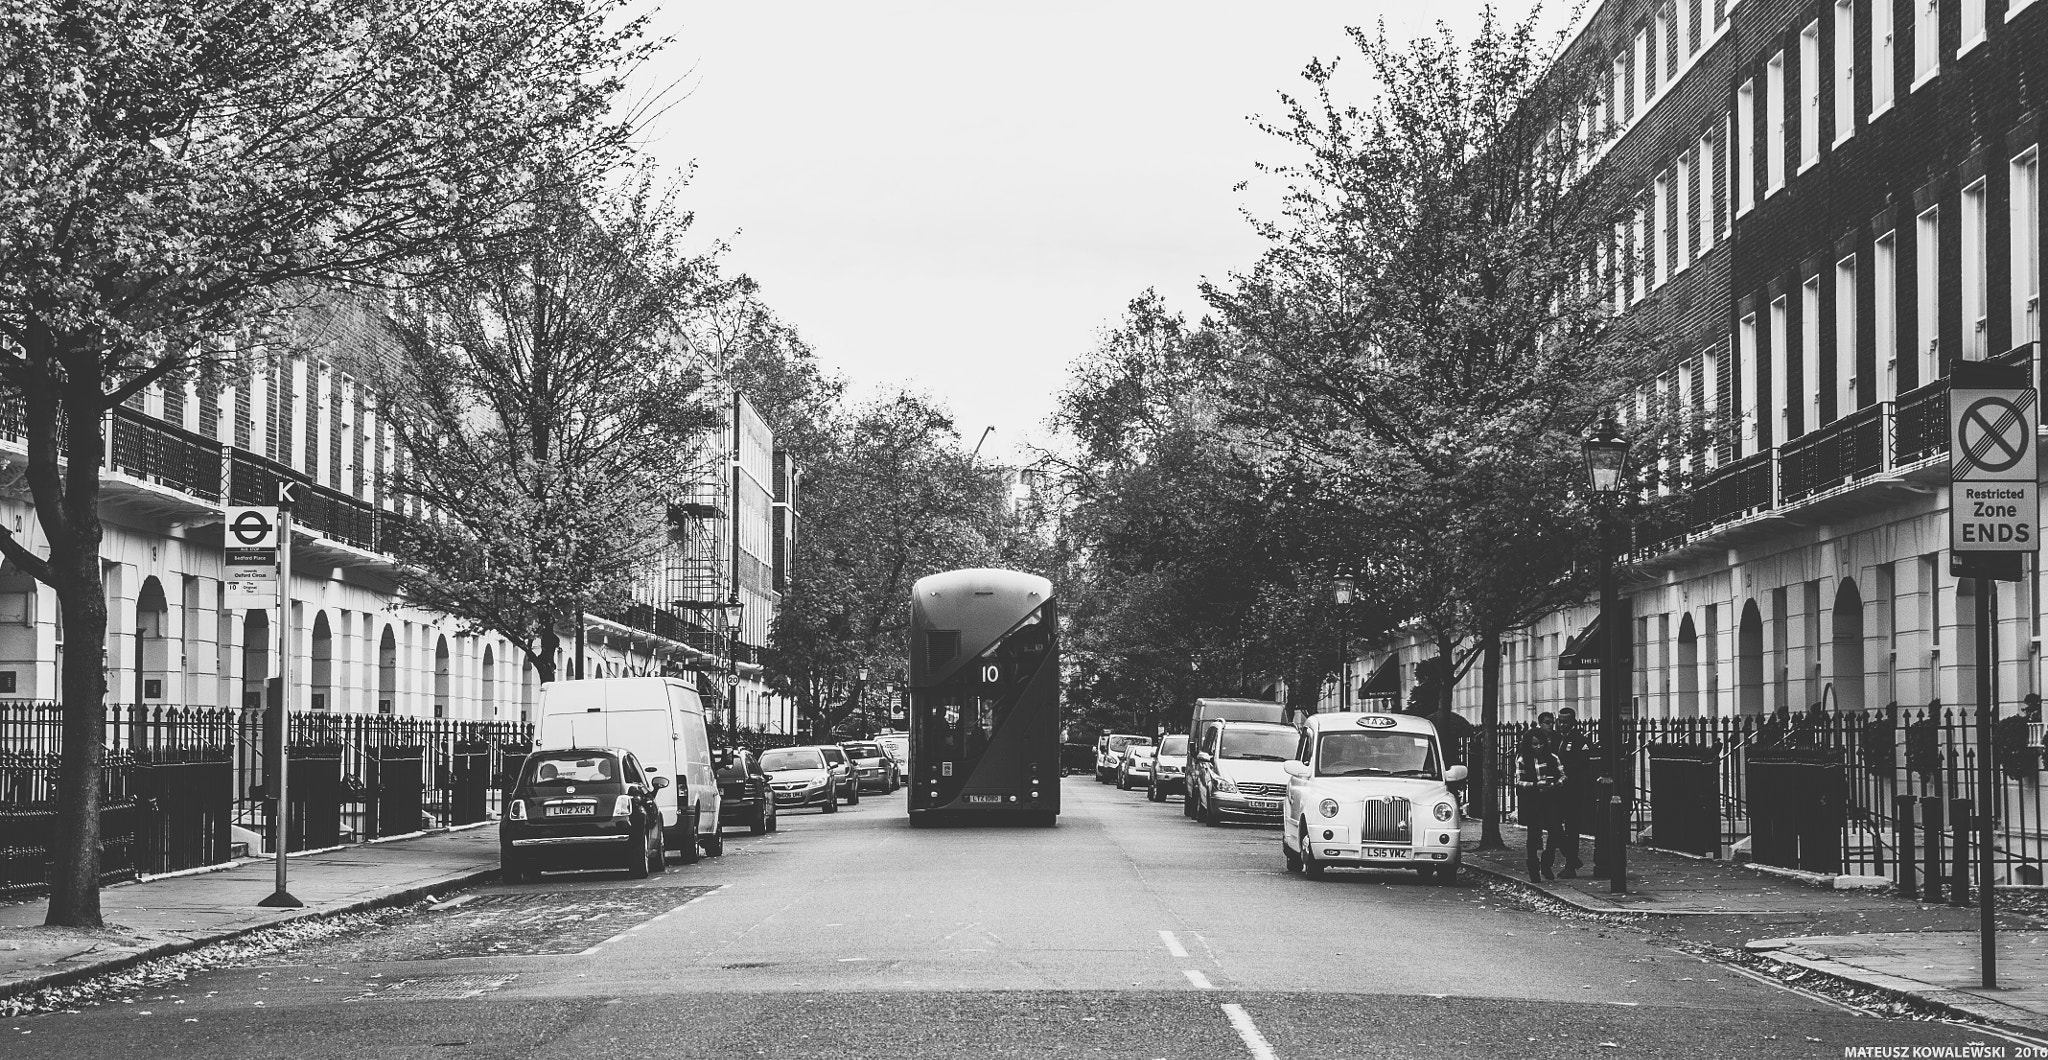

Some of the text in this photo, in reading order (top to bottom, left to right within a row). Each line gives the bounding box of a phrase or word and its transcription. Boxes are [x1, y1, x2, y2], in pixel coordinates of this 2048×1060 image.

[279, 482, 295, 502] K
[1966, 488, 2024, 500] Restricted
[1973, 502, 2017, 518] Zone
[1962, 523, 2030, 543] ENDS
[728, 676, 738, 684] 20
[982, 665, 999, 683] 10
[553, 805, 592, 815] LN12 XPK
[1367, 849, 1407, 858] LS15 VMZ
